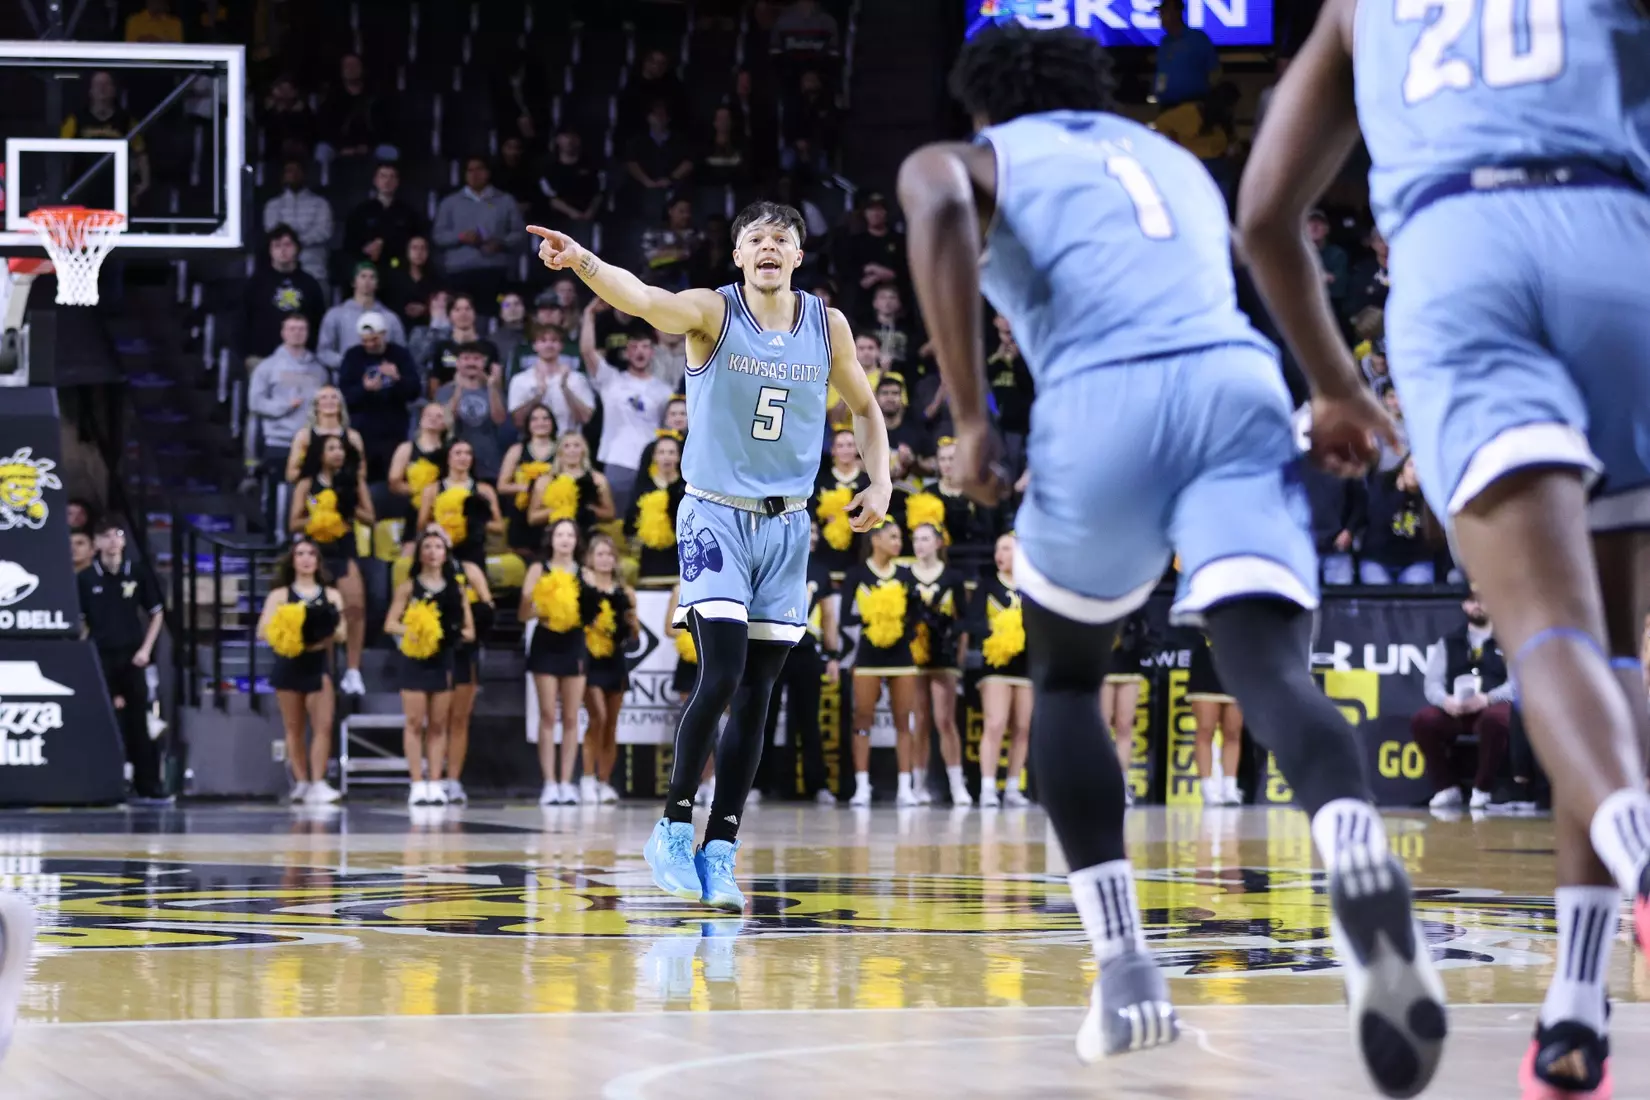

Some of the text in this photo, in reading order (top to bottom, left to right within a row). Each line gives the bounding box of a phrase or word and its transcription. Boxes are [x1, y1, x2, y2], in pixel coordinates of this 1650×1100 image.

[1394, 0, 1566, 106] 20
[1104, 155, 1175, 240] 1
[728, 353, 821, 382] KANSAS CITY
[751, 386, 789, 441] 5
[16, 610, 70, 629] BELL
[1378, 740, 1425, 779] GO
